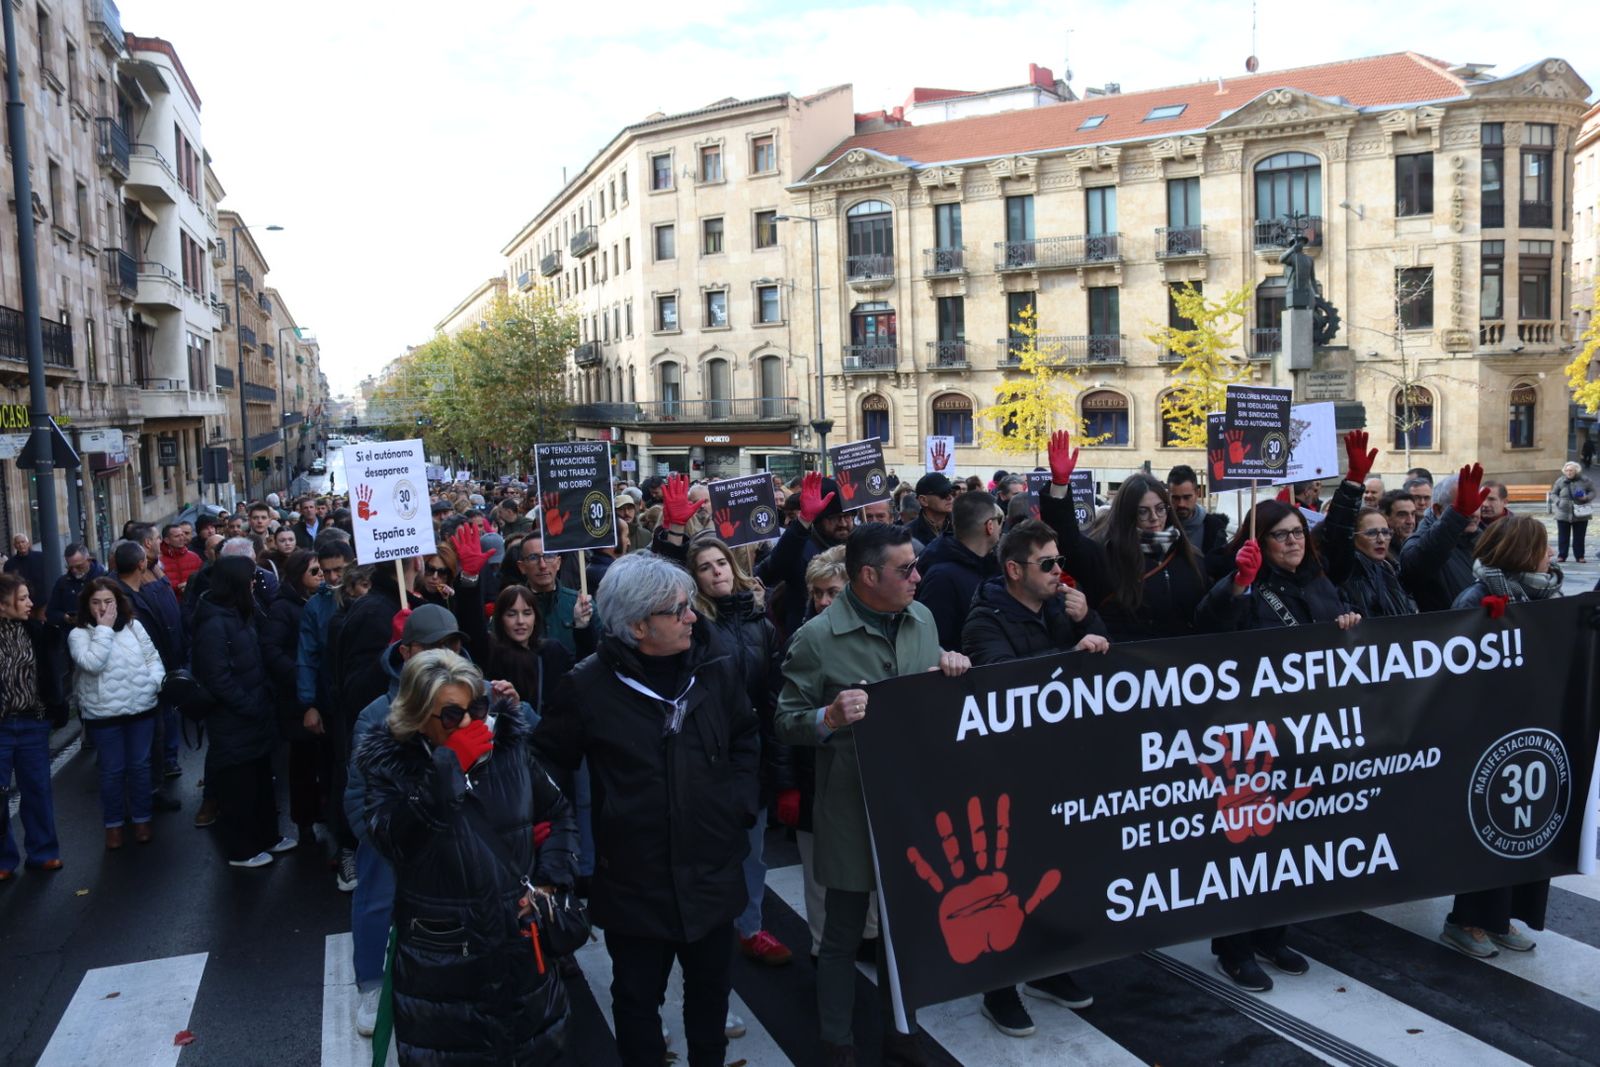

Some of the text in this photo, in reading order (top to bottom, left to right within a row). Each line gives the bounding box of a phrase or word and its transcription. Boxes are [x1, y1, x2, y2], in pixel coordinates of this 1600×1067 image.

[1237, 392, 1260, 400] COLORES
[1237, 401, 1246, 409] SIN
[704, 435, 730, 443] OPORTO
[540, 444, 603, 455] NO TENGO DERECHO
[1269, 440, 1280, 454] 30
[356, 449, 413, 462] Si el autónomo
[550, 458, 555, 466] A
[365, 466, 409, 478] desaparece
[550, 468, 597, 478] SI NO TRABAJO
[559, 479, 592, 489] NO COBRO
[871, 475, 881, 486] 30
[399, 489, 410, 503] 30
[730, 488, 754, 498] ESPAÑA
[404, 503, 409, 511] N
[590, 503, 603, 519] 30
[757, 512, 768, 523] 30
[1075, 509, 1086, 520] 30
[595, 519, 601, 528] N
[372, 527, 416, 543] España se
[374, 545, 420, 560] desvanece
[955, 629, 1524, 741] AUTÓNOMOS ASFIXIADOS!!
[1141, 706, 1366, 772] BASTA YA!!
[1234, 769, 1287, 796] POR
[1294, 766, 1326, 788] LA
[1331, 747, 1442, 784] DIGNIDAD
[1475, 735, 1568, 795] MANIFESTACION NACIONAL
[1501, 760, 1547, 805] 30
[1514, 804, 1532, 830] N
[1121, 823, 1151, 851] DE
[1158, 813, 1205, 843] LOS
[1482, 812, 1562, 852] DE AUTONOMOS
[1106, 832, 1399, 922] SALAMANCA
